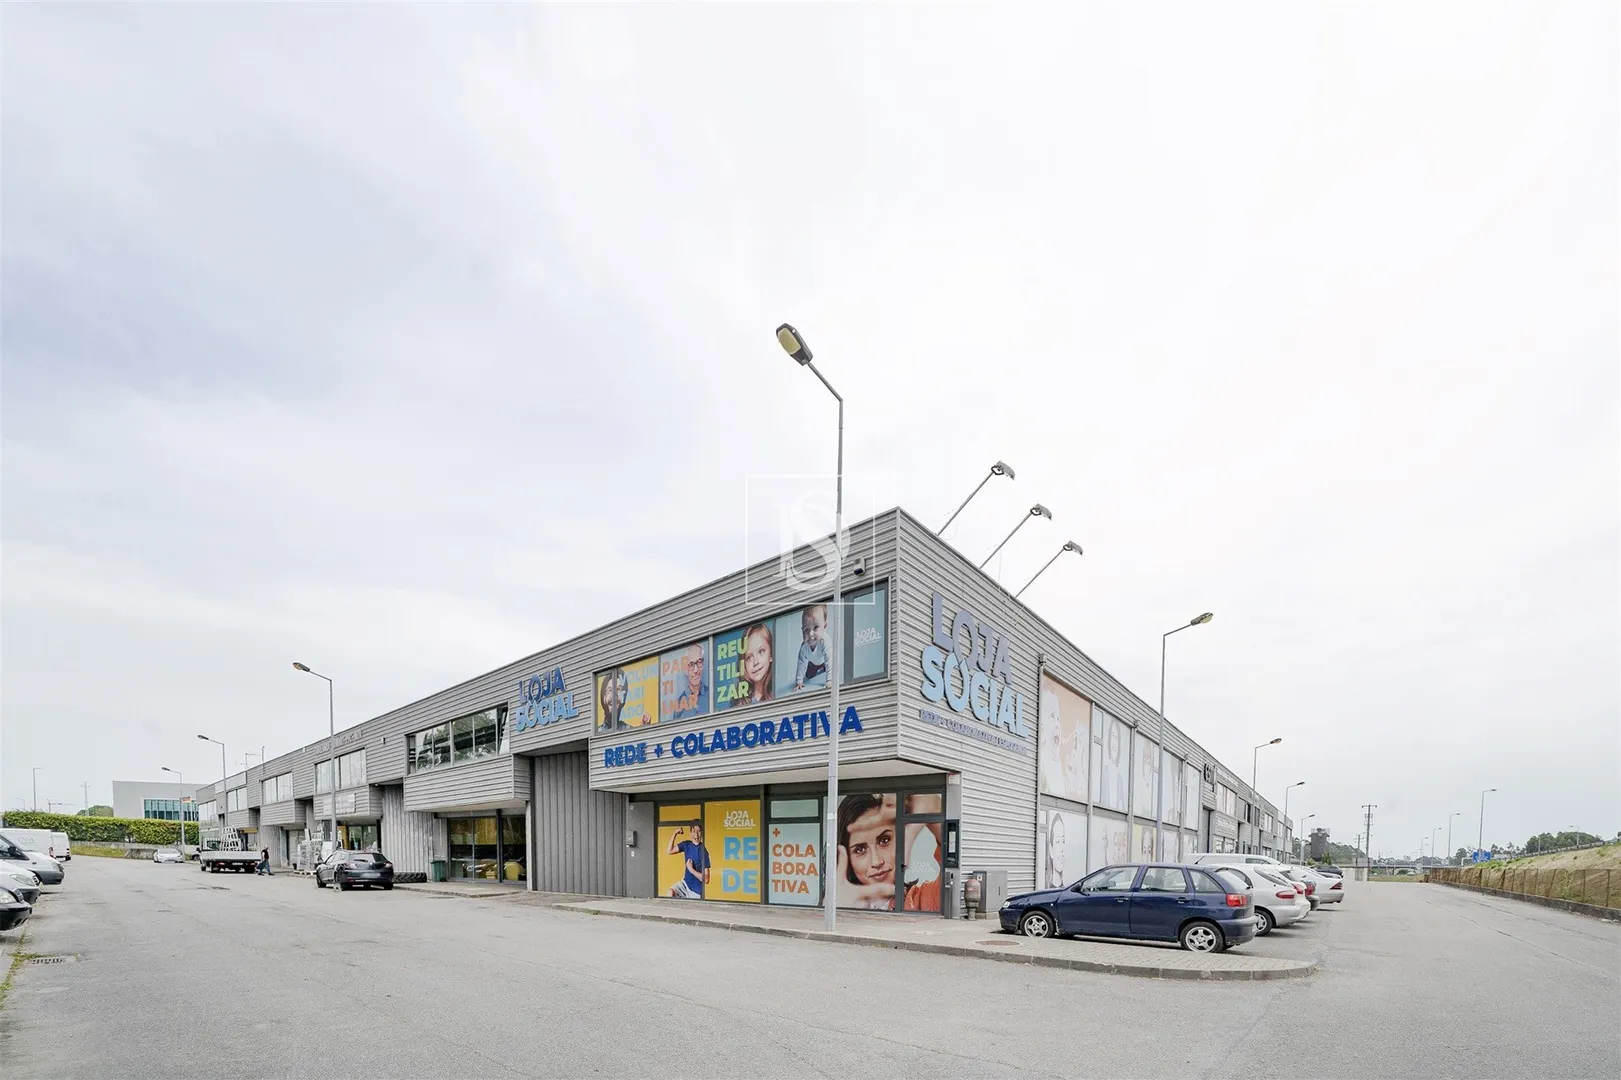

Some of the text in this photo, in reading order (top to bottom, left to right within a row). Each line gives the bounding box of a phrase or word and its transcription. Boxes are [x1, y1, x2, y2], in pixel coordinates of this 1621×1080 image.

[856, 627, 876, 641] LOJA
[932, 590, 1012, 685] LOJA
[717, 636, 749, 660] REU
[717, 659, 745, 681] TILI
[518, 665, 567, 705] LOJA
[717, 681, 749, 703] ZAR
[920, 645, 1029, 738] SOCIAL
[515, 691, 579, 732] SOCIAL
[604, 742, 647, 768] REDE
[723, 818, 756, 828] SOCIAL
[725, 810, 748, 820] LOJA
[724, 836, 758, 861] RE
[772, 844, 817, 858] COLA
[772, 862, 819, 876] BORA
[722, 868, 758, 894] DE
[772, 879, 810, 894] TIVA
